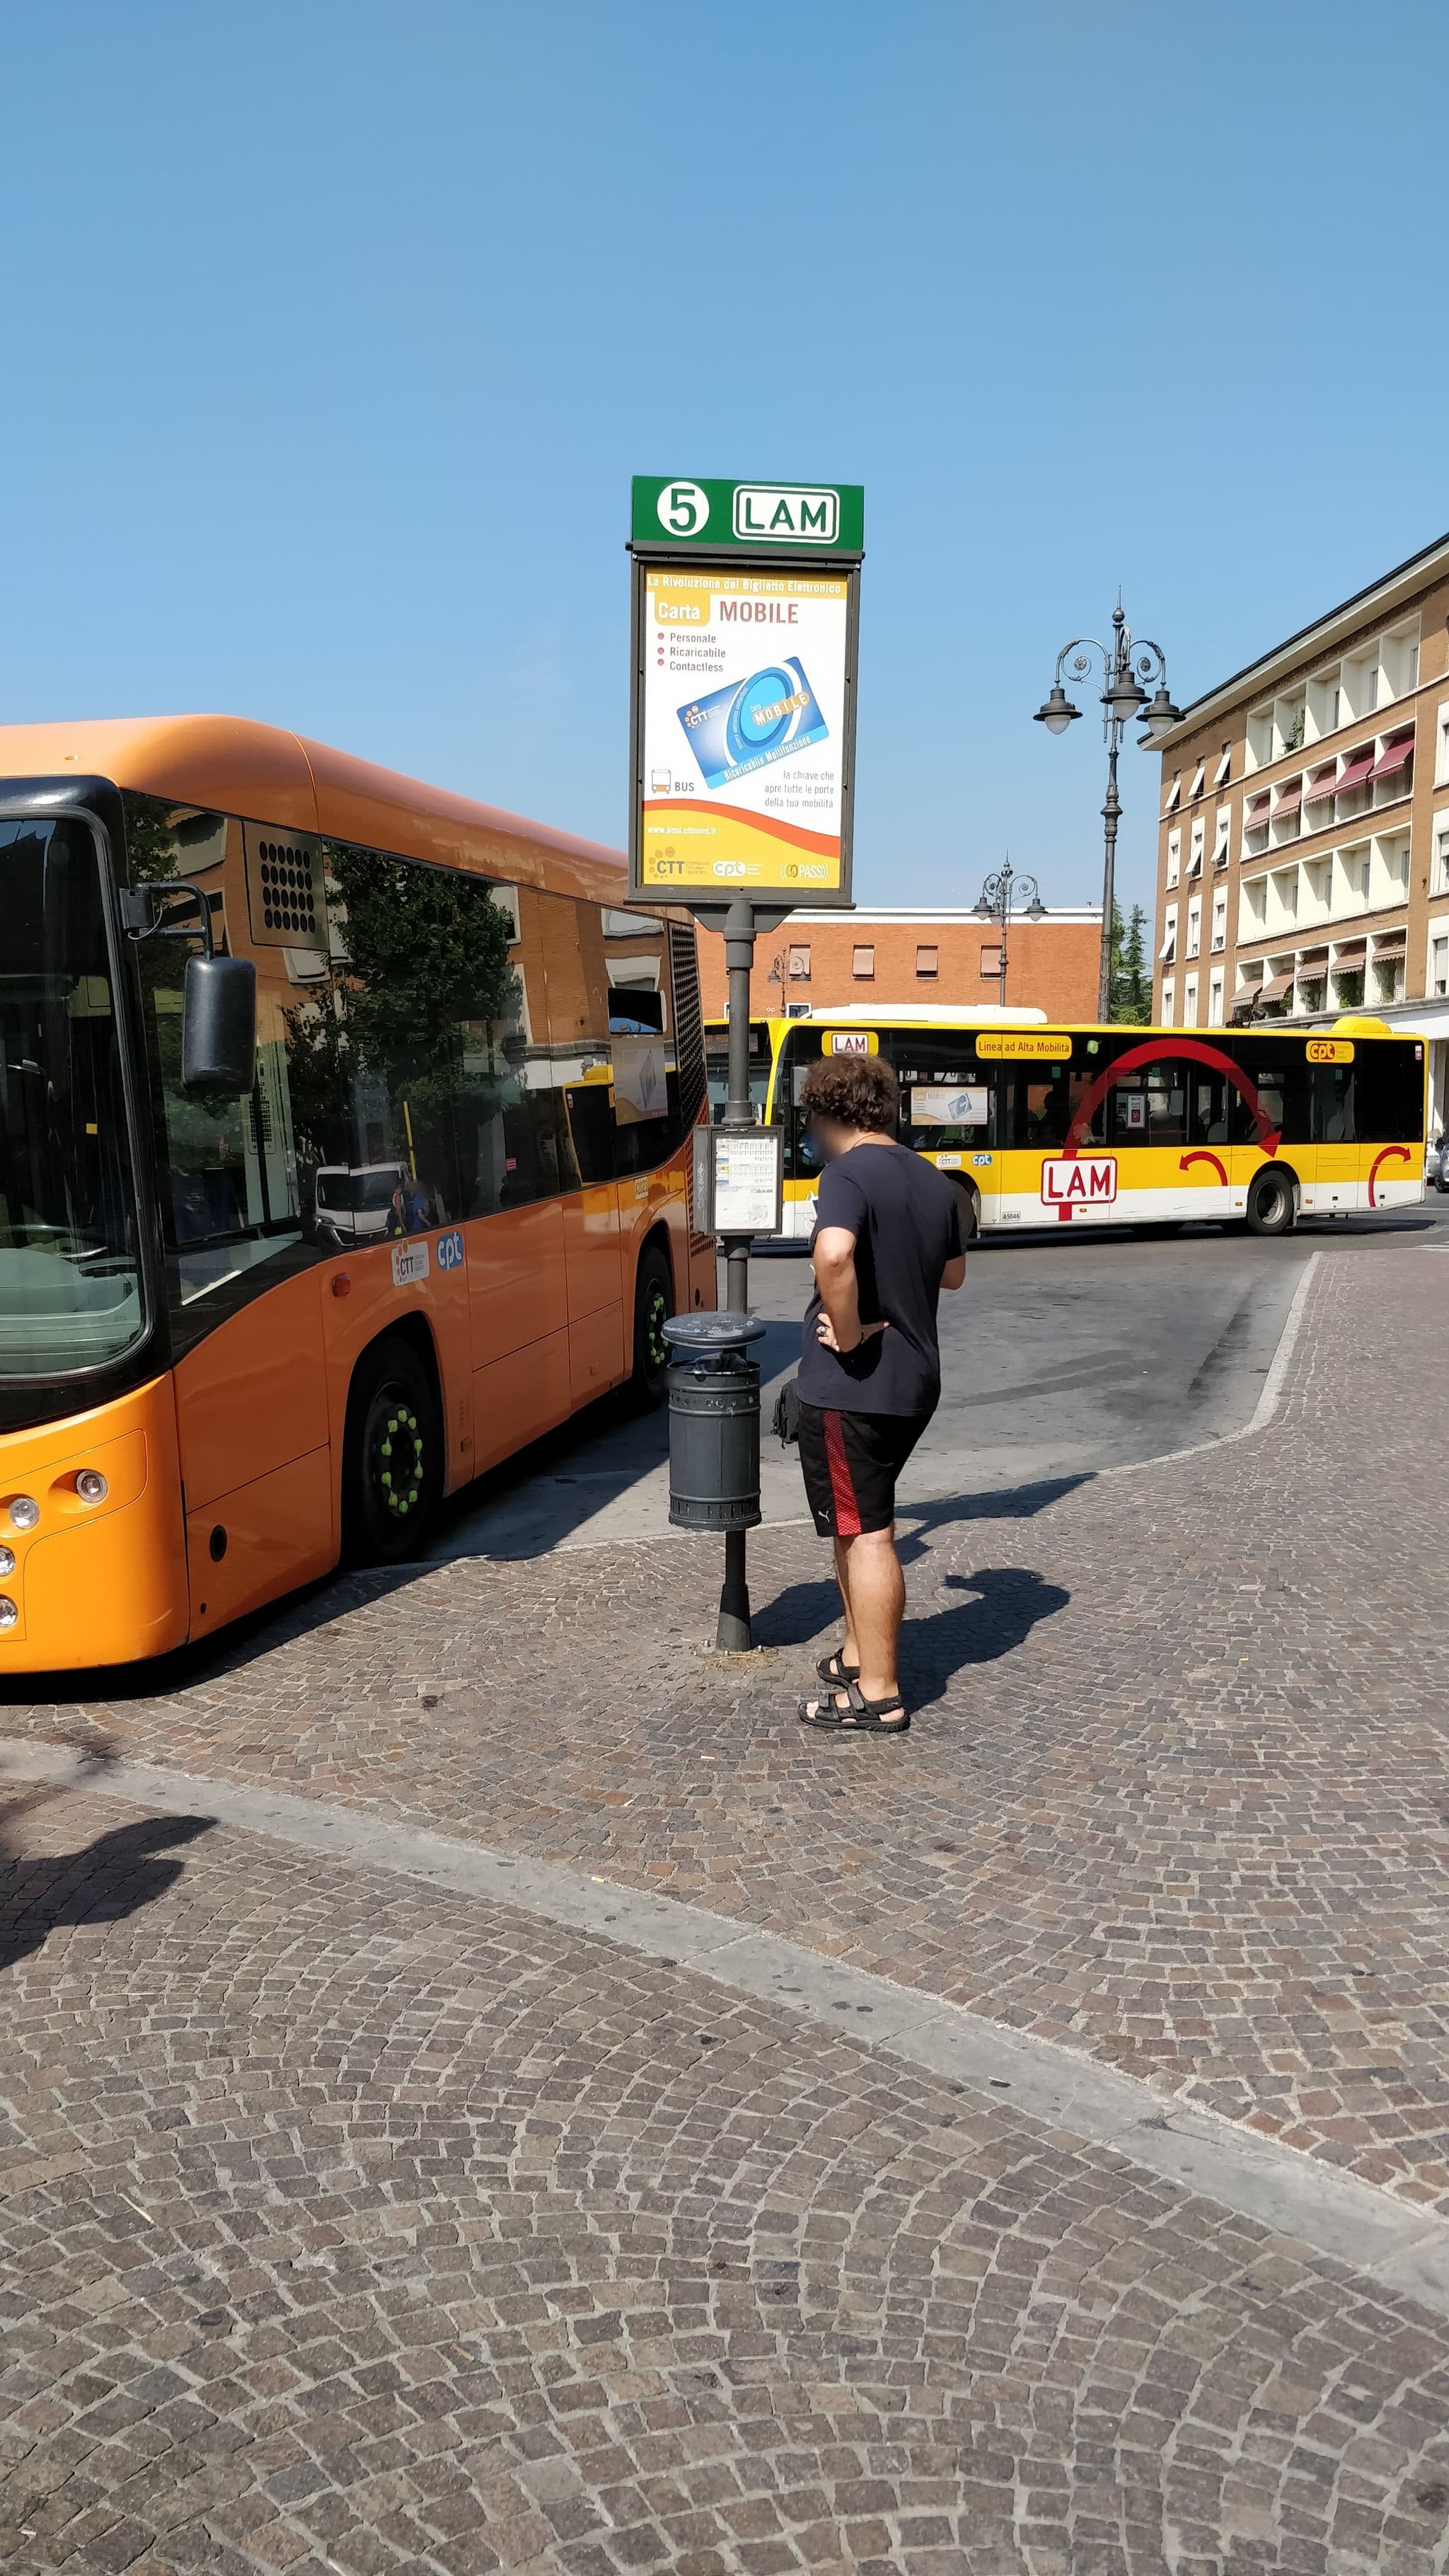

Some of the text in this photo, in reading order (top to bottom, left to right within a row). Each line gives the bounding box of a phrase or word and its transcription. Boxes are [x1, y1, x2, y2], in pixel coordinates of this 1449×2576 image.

[669, 489, 697, 532] 5
[745, 498, 827, 533] LAM
[647, 576, 841, 594] La Rivoluzione del Biglietto Elettronico
[658, 601, 799, 624] Carta MOBILE
[670, 632, 717, 643] Personale
[669, 646, 726, 658] Ricaricabile
[669, 661, 724, 672] Contactless
[753, 693, 809, 726] MOBILE
[690, 711, 708, 726] CTT
[723, 736, 812, 781] Ricaricabile Multifunzione
[783, 769, 834, 781] la chiave che
[674, 782, 695, 792] BUS
[764, 783, 834, 795] apre tutte le porte
[765, 797, 833, 808] della tua mobilità
[657, 860, 685, 874] CTT
[715, 861, 744, 876] cpt
[799, 865, 823, 878] PASS
[835, 1037, 865, 1052] LAM
[978, 1041, 1002, 1052] Linea
[1005, 1041, 1015, 1052] ad
[1018, 1042, 1034, 1052] Alta
[1310, 1043, 1335, 1060] cpt
[972, 1154, 991, 1166] cpt
[1048, 1164, 1110, 1198] LAM
[437, 1231, 463, 1270] cpt
[400, 1256, 415, 1276] CTT
